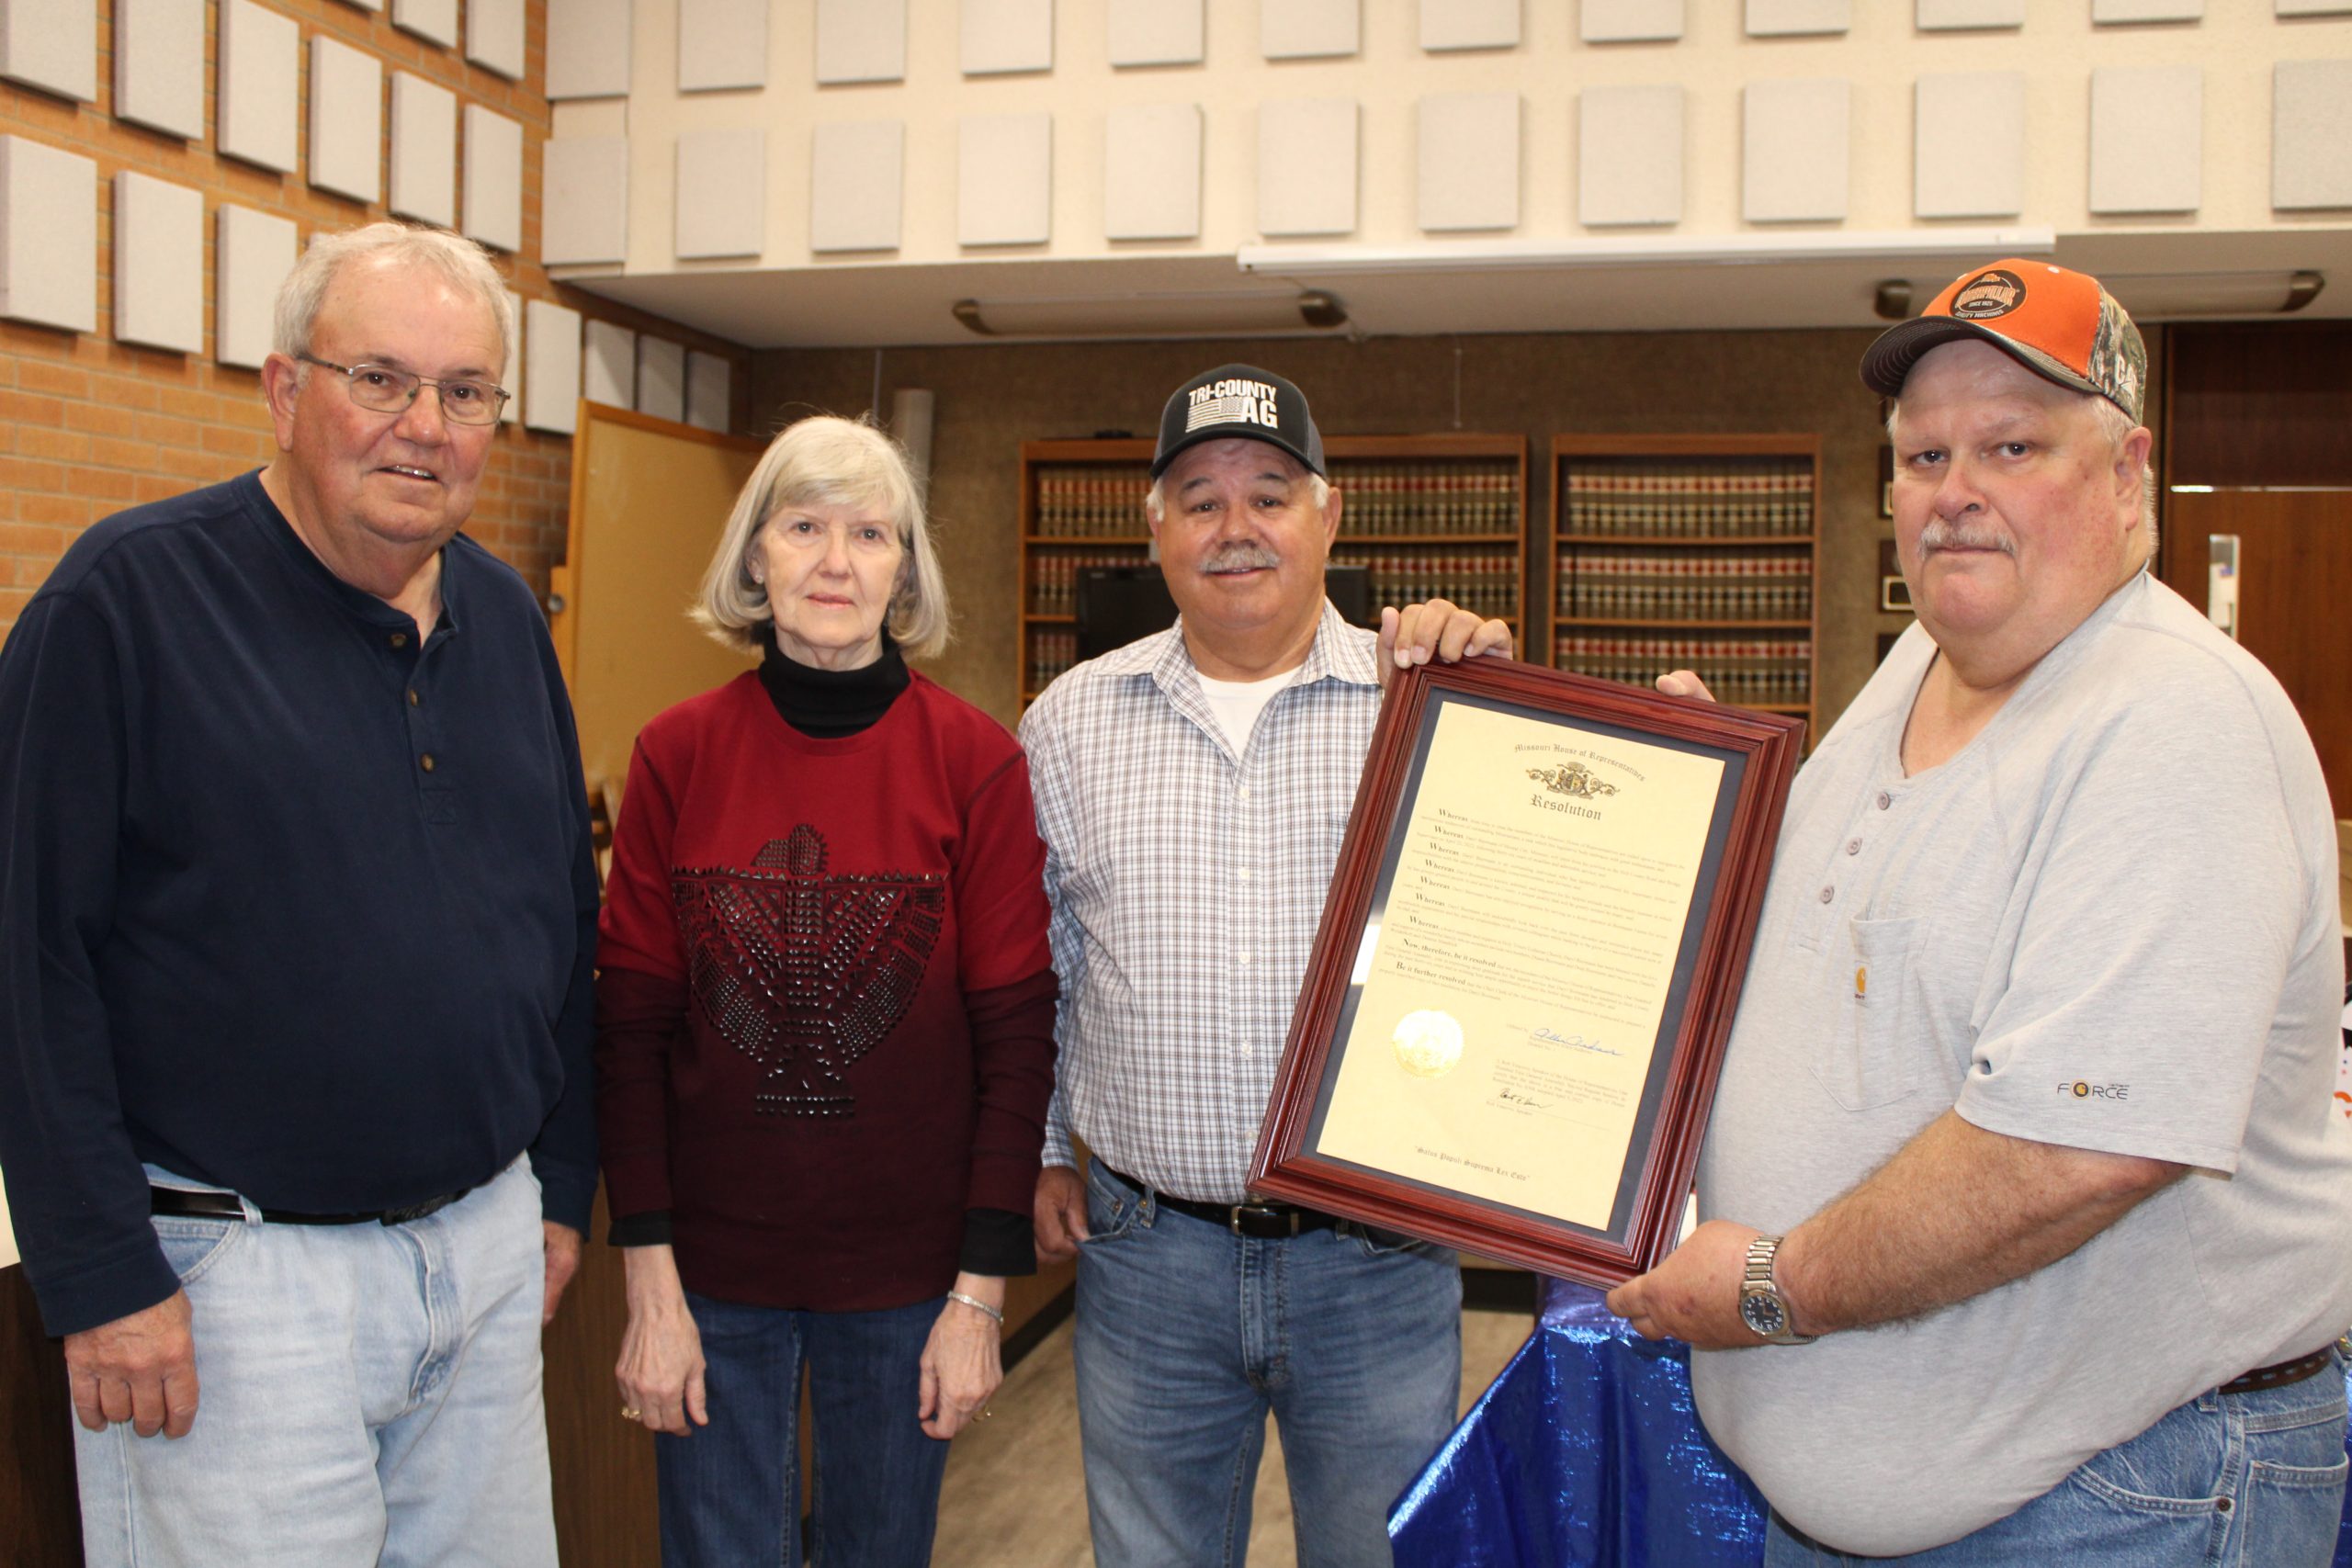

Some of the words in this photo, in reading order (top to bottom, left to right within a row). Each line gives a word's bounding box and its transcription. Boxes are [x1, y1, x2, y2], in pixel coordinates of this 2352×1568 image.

[1189, 378, 1277, 406] TRI-COUNTY
[1240, 396, 1278, 429] AG
[1514, 743, 1551, 753] Missouri
[1554, 743, 1577, 756] House
[1578, 750, 1588, 758] of
[1589, 751, 1646, 782] Representatives
[1530, 793, 1602, 821] Resolution
[1396, 962, 1406, 971] Be
[1413, 965, 1438, 979] further
[1439, 973, 1466, 986] resolved
[1469, 956, 1497, 968] resolved
[2057, 1080, 2129, 1100] FORCE
